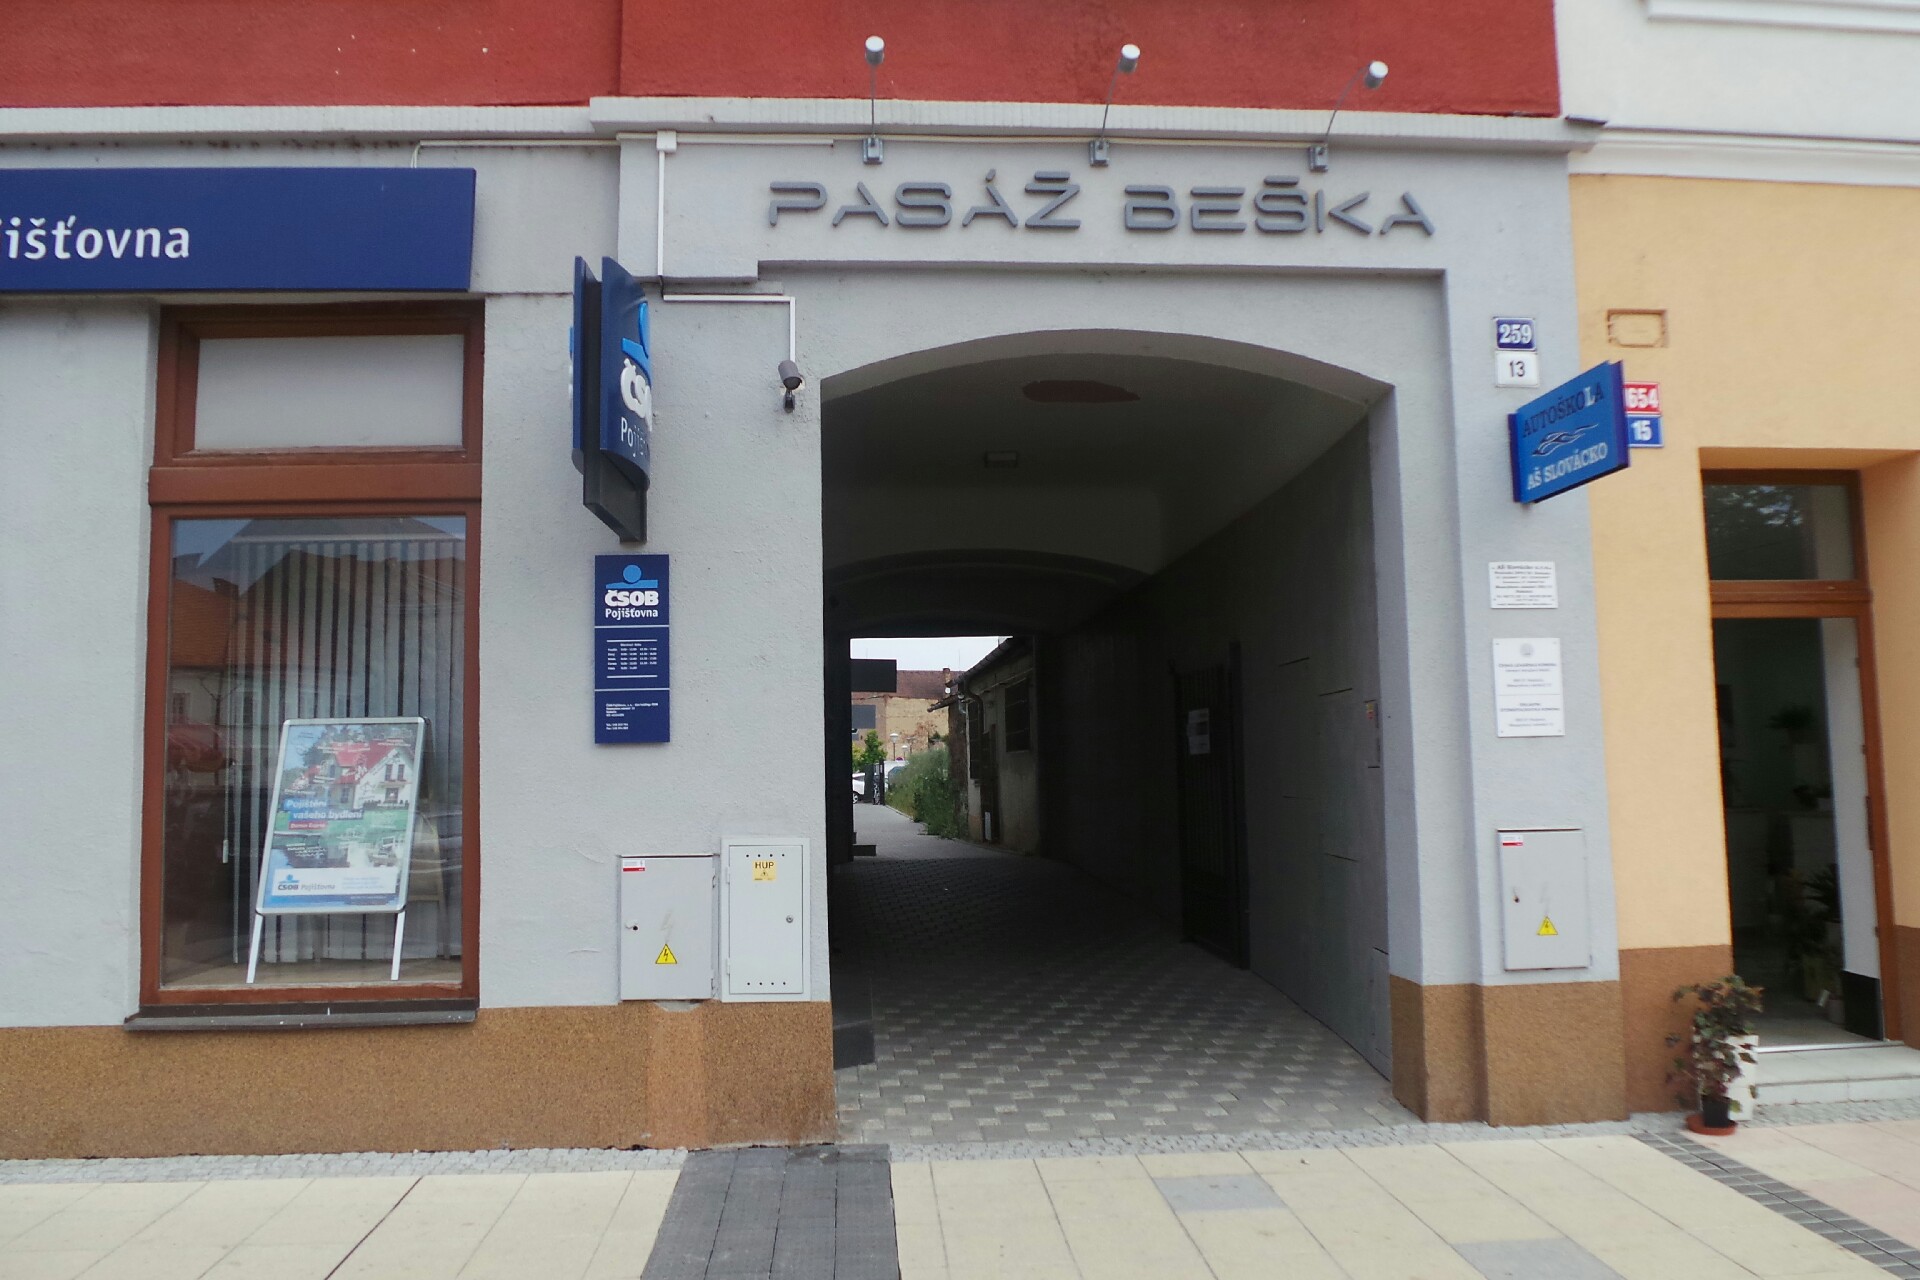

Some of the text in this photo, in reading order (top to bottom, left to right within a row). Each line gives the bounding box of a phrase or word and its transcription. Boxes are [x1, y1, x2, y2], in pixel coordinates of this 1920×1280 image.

[769, 168, 1436, 237] PASÁŽ BEŠKA
[0, 214, 191, 260] išťovna
[1498, 323, 1533, 345] 259
[1509, 360, 1526, 378] 13
[620, 357, 653, 432] ČS
[1522, 381, 1606, 438] AUTOŠKOLA
[1631, 419, 1652, 441] 15
[1543, 441, 1609, 482] SLOVÁCKO
[604, 589, 660, 607] ČSOB
[605, 607, 659, 621] Pojišťovna
[286, 799, 327, 810] Pojištění
[328, 809, 362, 820] bydlení
[755, 861, 775, 869] HUP
